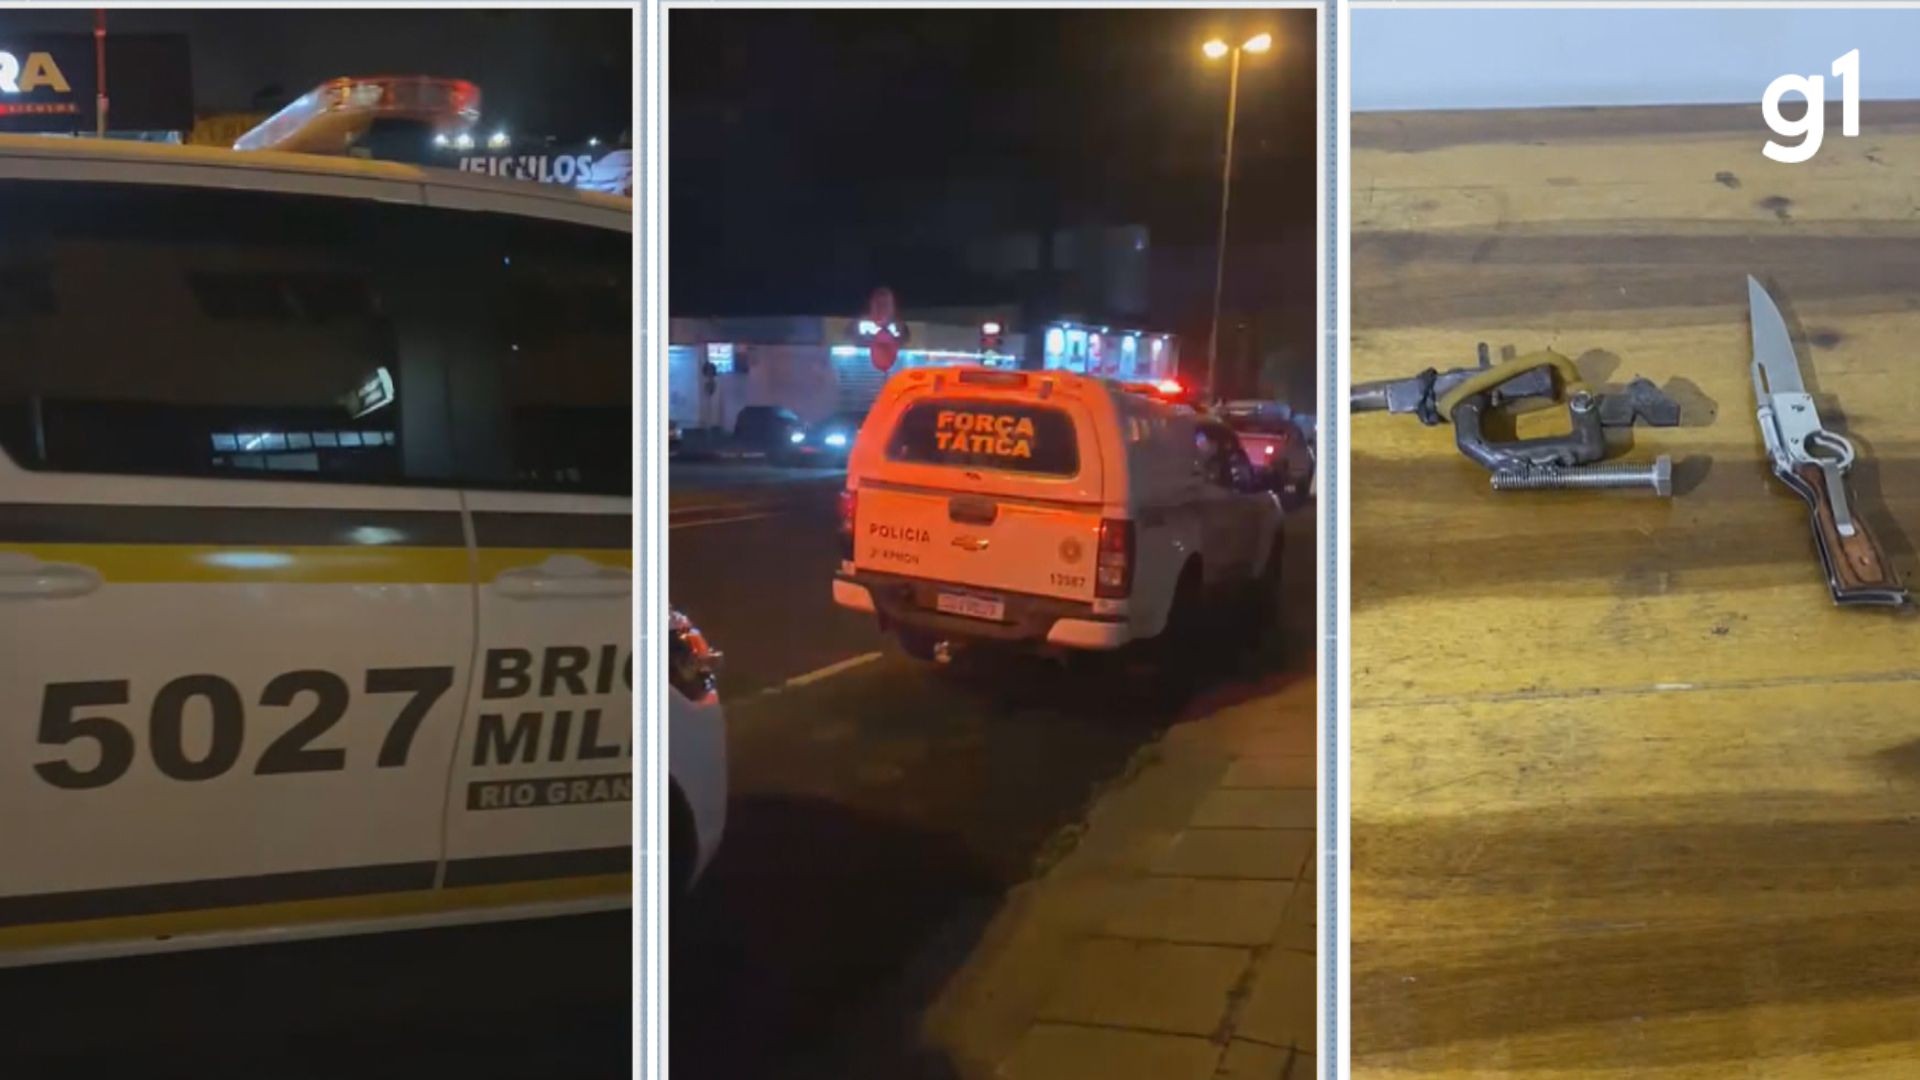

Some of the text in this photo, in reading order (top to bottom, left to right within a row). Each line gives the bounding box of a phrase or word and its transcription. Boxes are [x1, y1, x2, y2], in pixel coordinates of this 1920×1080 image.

[32, 666, 455, 791] 5027
[471, 707, 633, 767] MIL
[479, 783, 536, 808] RIO
